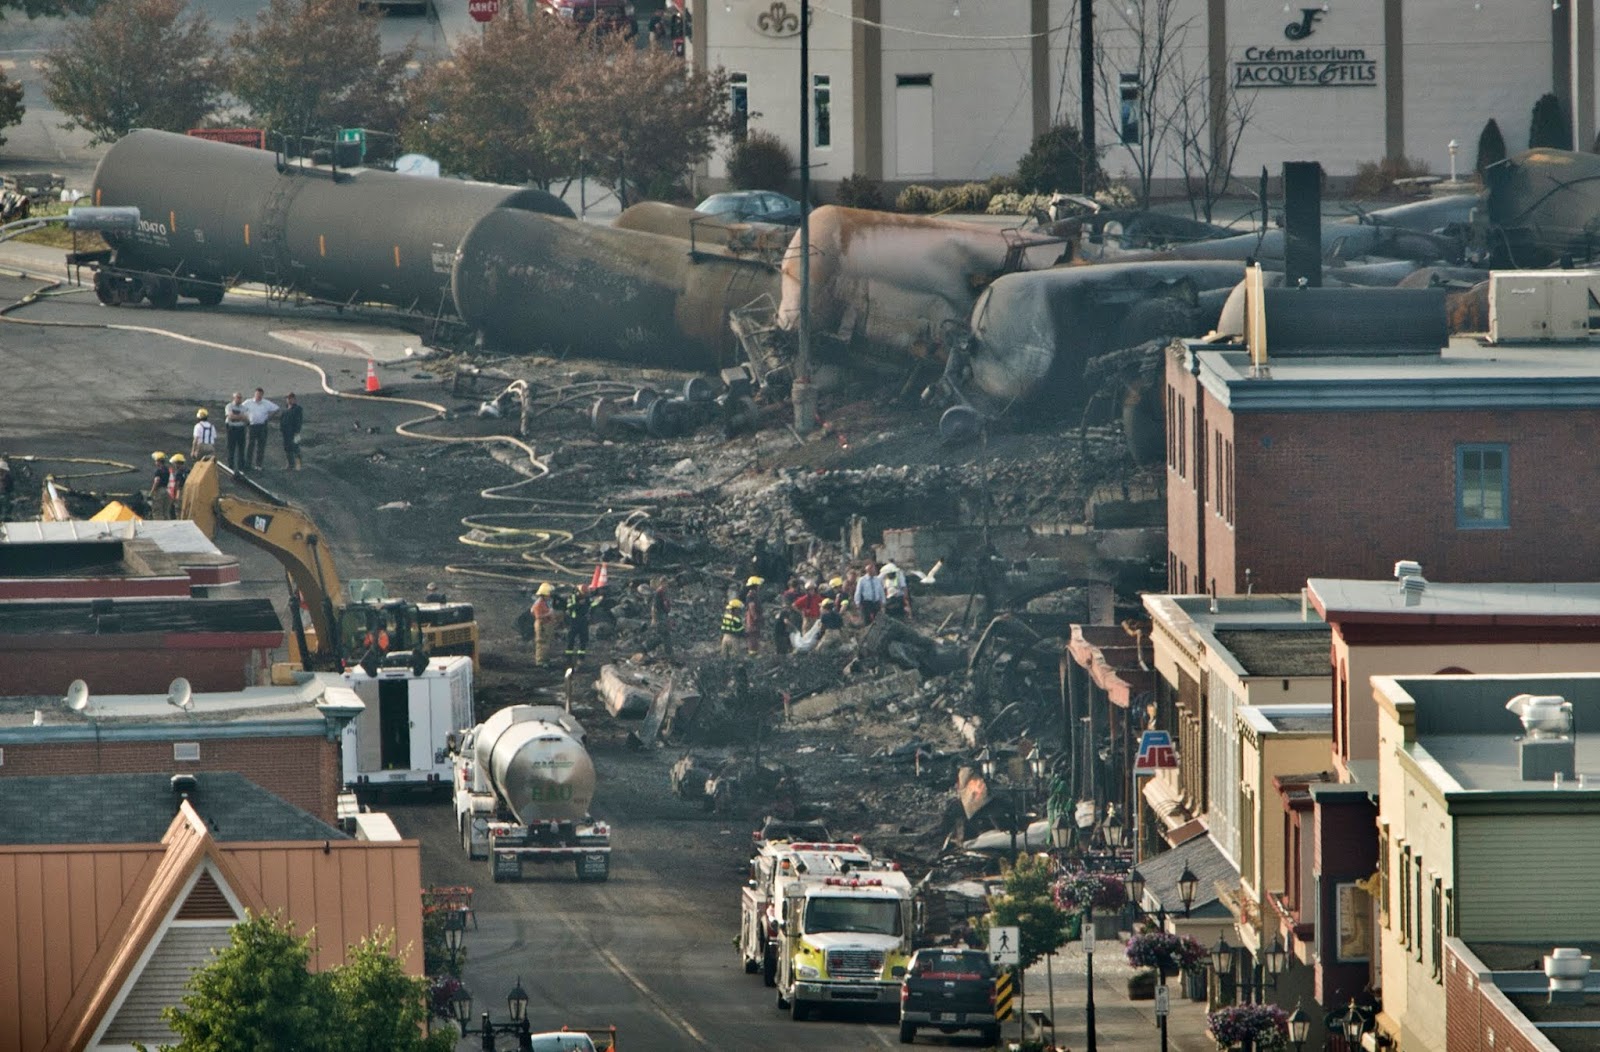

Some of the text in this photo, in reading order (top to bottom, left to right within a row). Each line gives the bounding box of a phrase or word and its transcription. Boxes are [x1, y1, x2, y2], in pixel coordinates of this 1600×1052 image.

[1245, 46, 1366, 62] Crématorium
[1235, 66, 1318, 87] JACQUES
[1340, 65, 1376, 81] FILS
